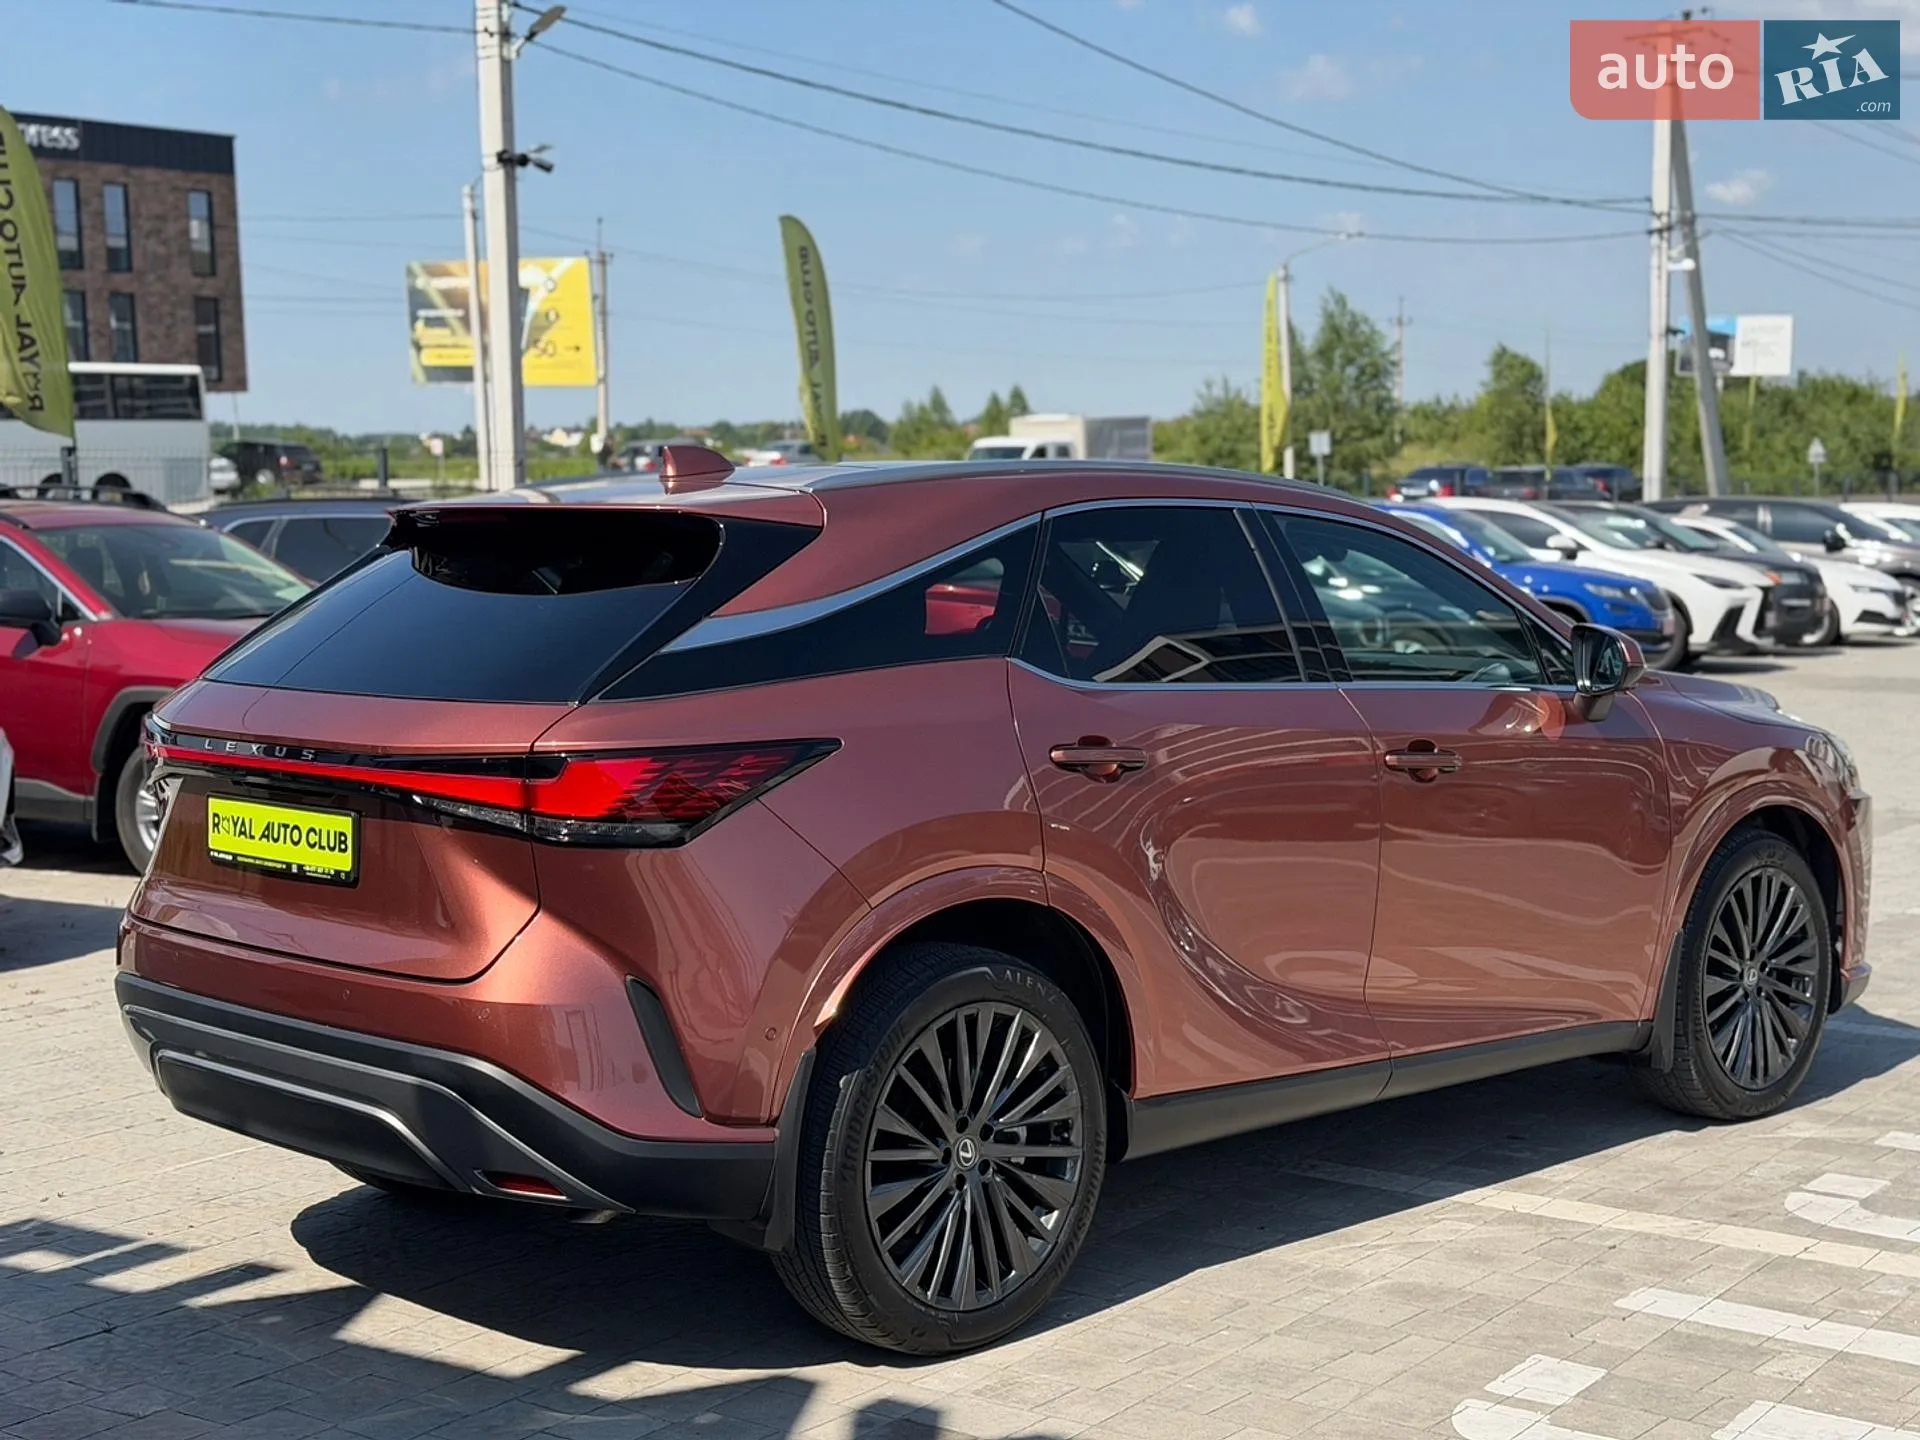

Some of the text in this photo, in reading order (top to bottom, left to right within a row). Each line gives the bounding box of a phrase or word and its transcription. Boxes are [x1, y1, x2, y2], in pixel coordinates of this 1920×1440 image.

[203, 739, 316, 760] LEXUS
[259, 821, 302, 847] AUTO
[305, 826, 348, 853] CLUB
